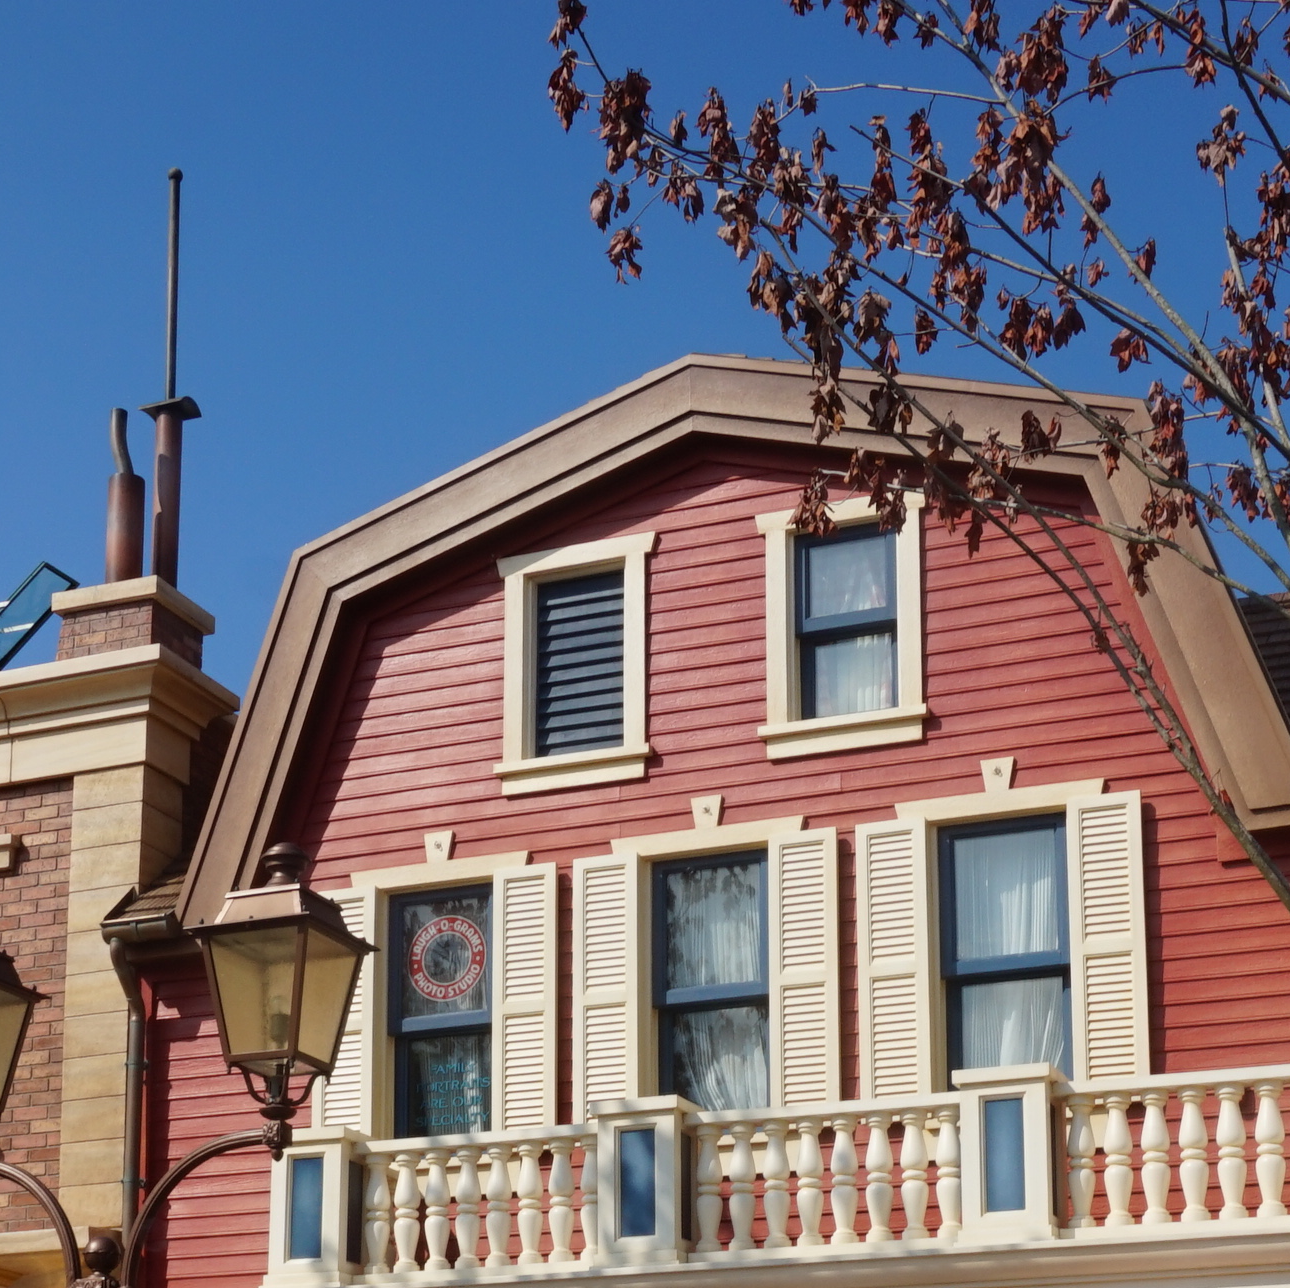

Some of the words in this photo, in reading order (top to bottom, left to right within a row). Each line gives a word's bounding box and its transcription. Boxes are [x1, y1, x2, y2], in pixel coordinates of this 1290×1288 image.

[412, 919, 483, 960] LAUGH-O-GRAMS
[414, 972, 445, 997] PHOTO
[448, 964, 480, 997] STUDIO
[431, 1061, 476, 1074] FAMILY
[420, 1097, 449, 1109] ARE
[452, 1095, 484, 1107] OUR
[415, 1111, 489, 1127] SPECIALTY
